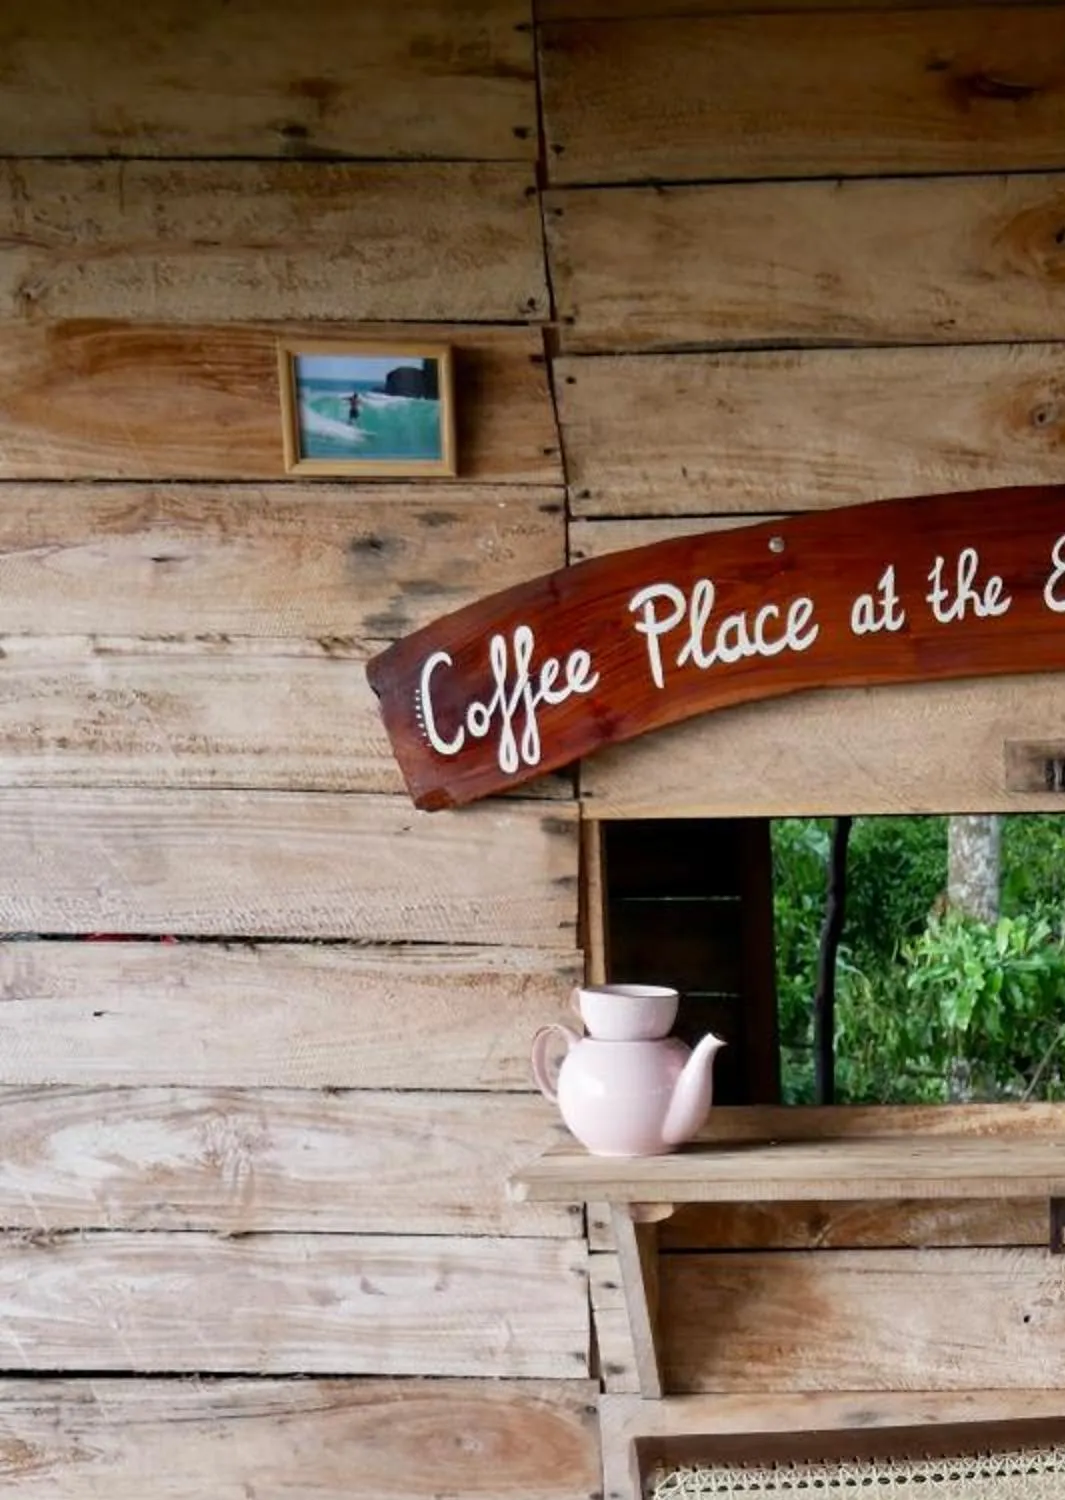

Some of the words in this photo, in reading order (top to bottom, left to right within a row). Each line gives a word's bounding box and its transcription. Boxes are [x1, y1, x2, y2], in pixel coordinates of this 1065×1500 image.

[416, 625, 600, 774] Coffee
[628, 578, 819, 689] Place
[851, 564, 905, 635] at
[926, 547, 1012, 623] the
